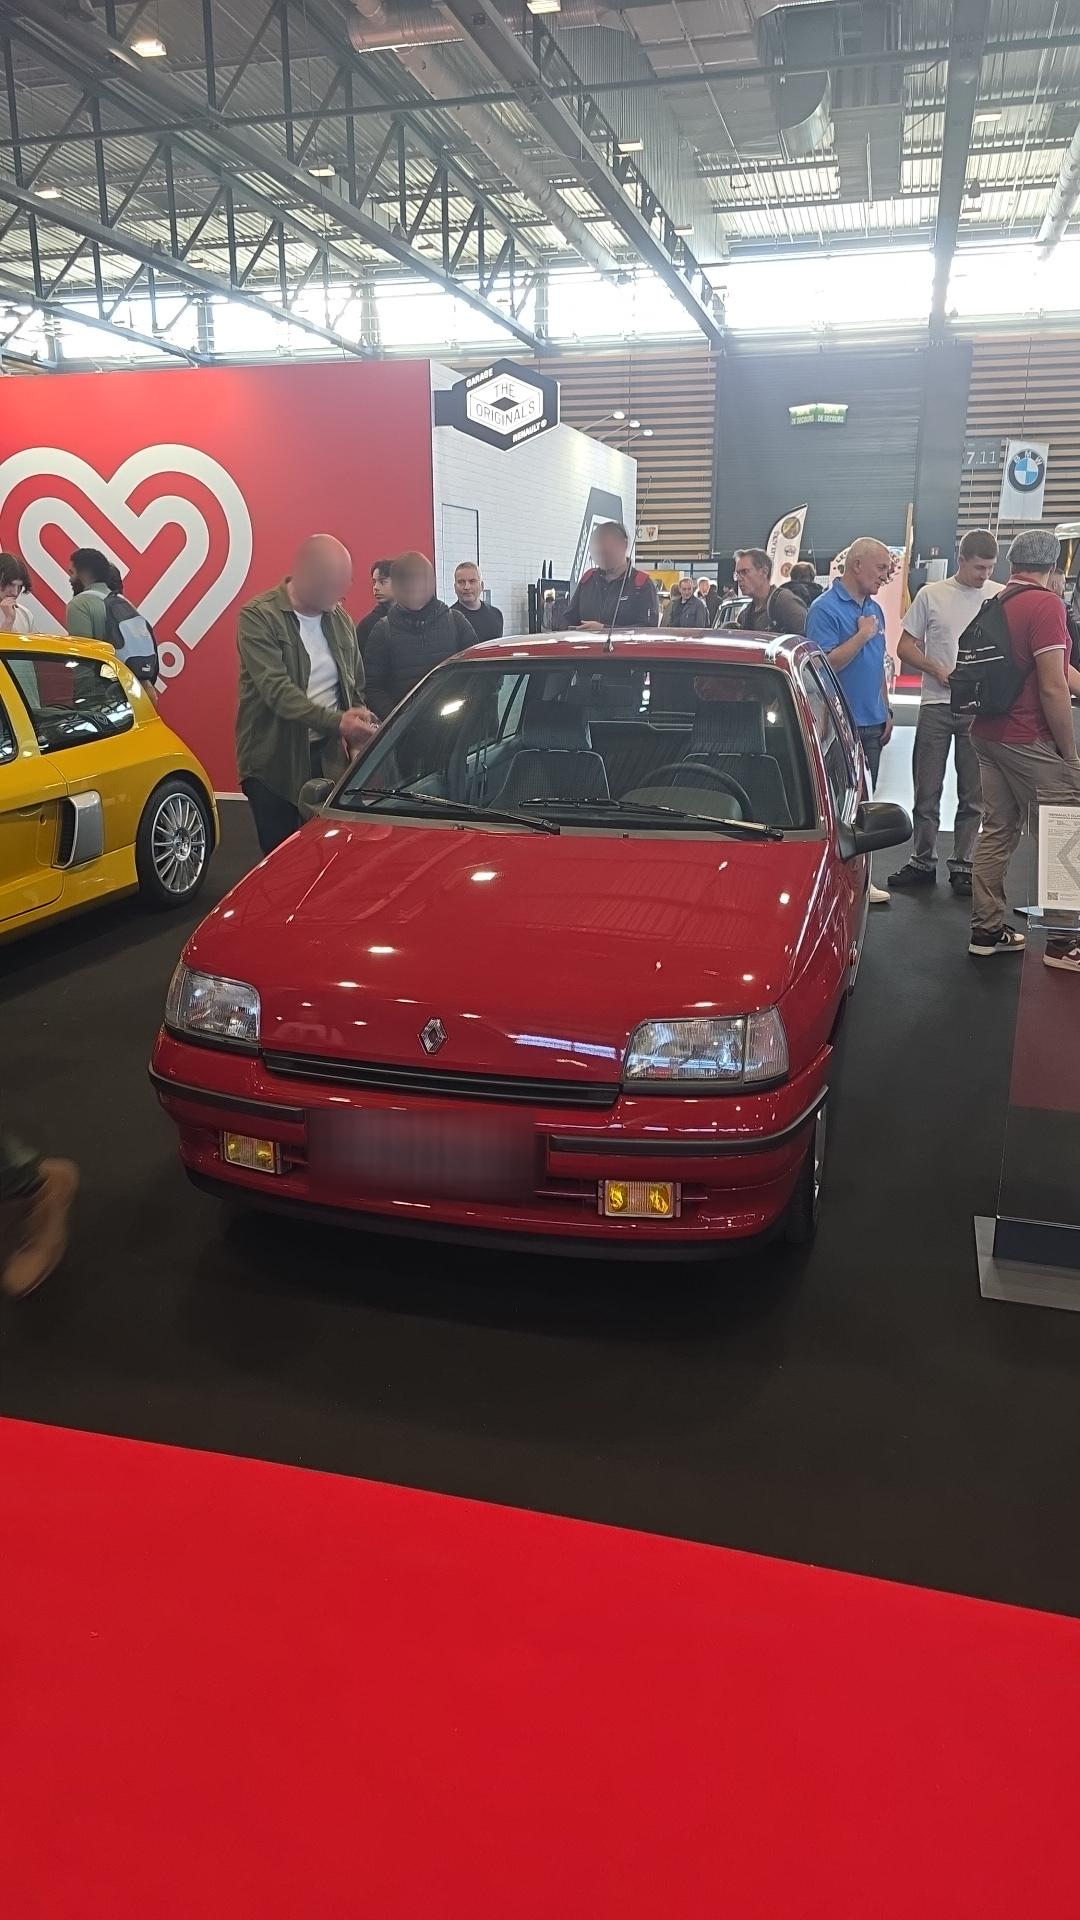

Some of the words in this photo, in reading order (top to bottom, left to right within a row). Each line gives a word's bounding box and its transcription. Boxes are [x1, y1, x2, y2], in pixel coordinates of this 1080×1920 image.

[466, 368, 494, 388] GARAGE
[494, 383, 516, 398] THE
[475, 400, 535, 426] ORIGINALS
[512, 422, 541, 443] RENAULT
[966, 450, 997, 465] 7.11
[1013, 450, 1044, 466] BMW
